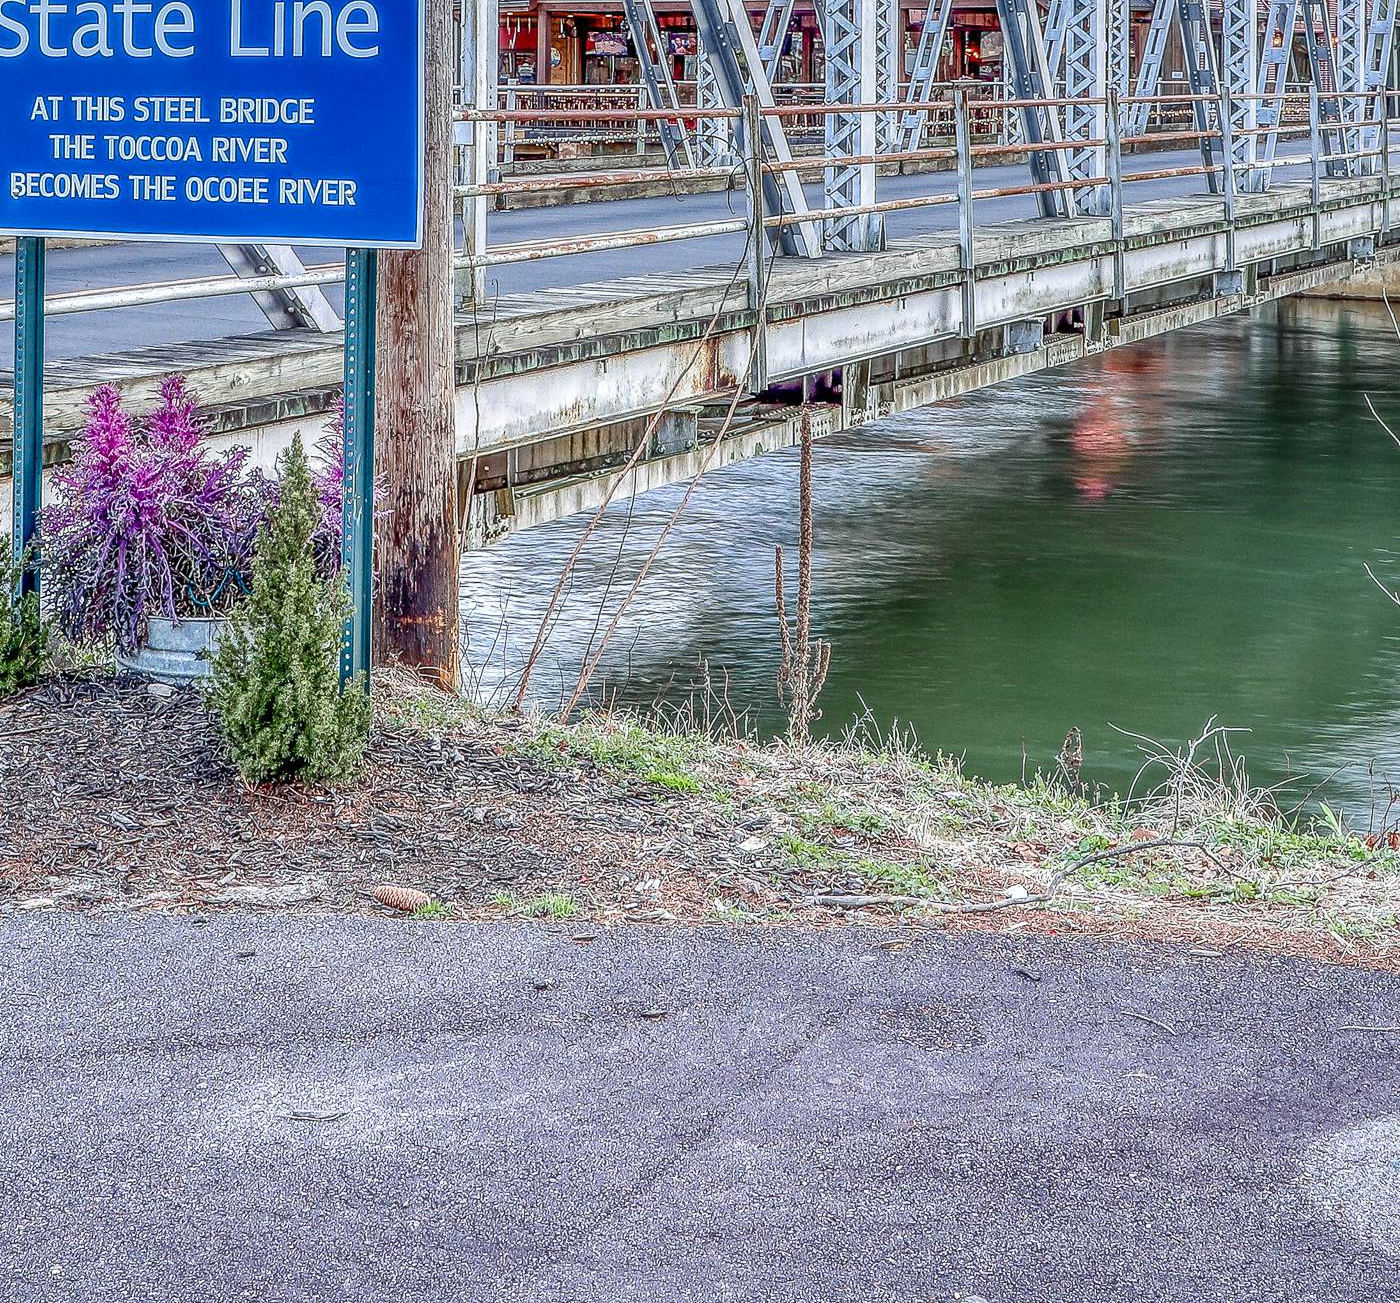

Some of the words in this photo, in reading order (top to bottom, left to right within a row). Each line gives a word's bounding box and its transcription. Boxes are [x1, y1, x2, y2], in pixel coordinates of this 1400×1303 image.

[30, 96, 63, 121] AT
[71, 96, 126, 122] THIS
[133, 96, 211, 123] STEEL
[219, 98, 315, 124] BRIDGE
[49, 134, 96, 160] THE
[103, 135, 202, 162] TOCCOA
[211, 137, 288, 164] RIVER
[10, 172, 120, 200] BECOMES
[128, 174, 177, 201] THE
[185, 175, 270, 204] OCOEE
[279, 178, 358, 206] RIVER
